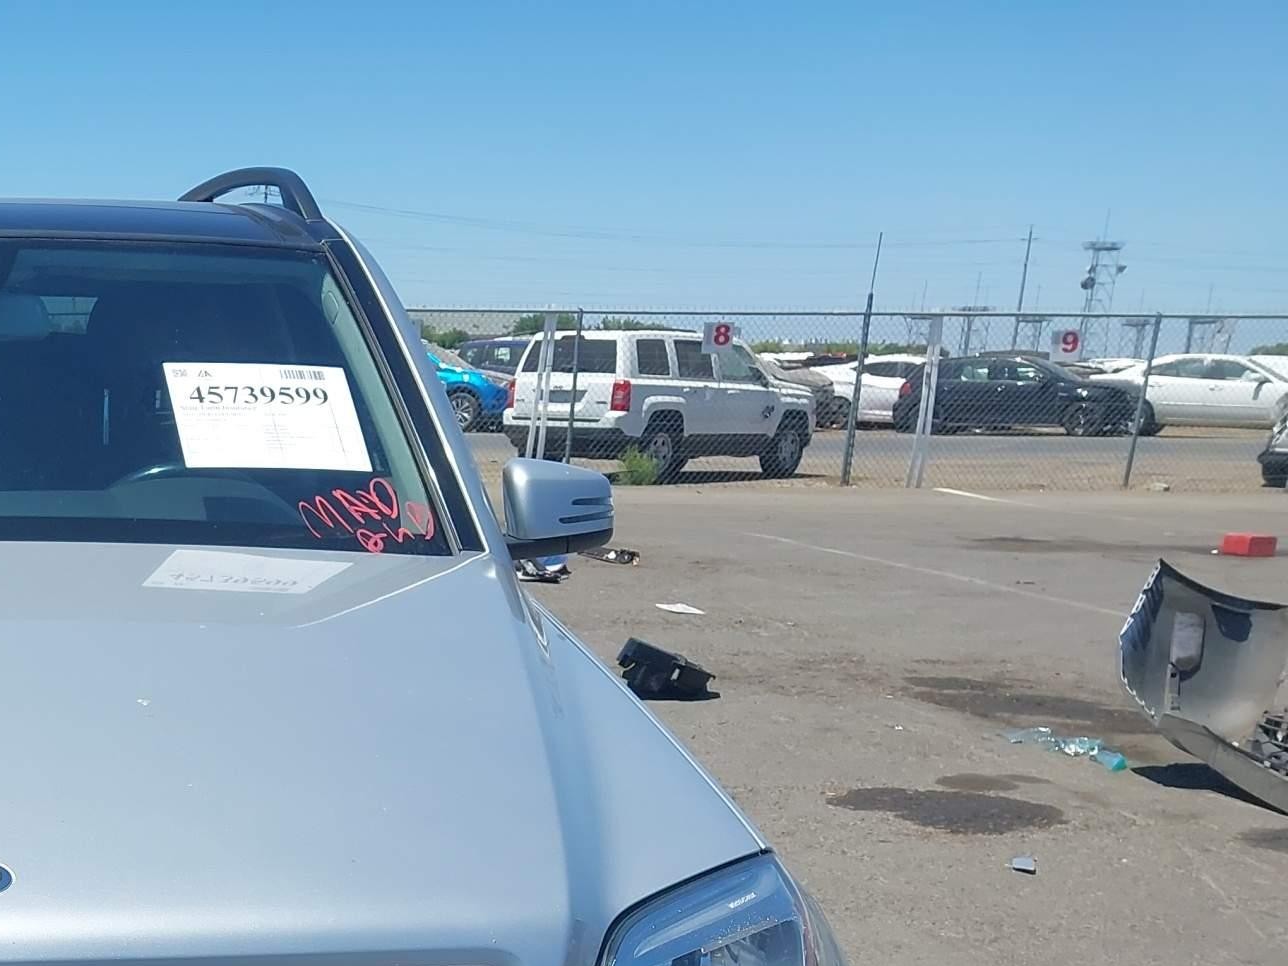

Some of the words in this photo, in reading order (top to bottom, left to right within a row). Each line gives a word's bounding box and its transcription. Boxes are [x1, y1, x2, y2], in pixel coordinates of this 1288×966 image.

[714, 324, 730, 346] 8
[1062, 331, 1079, 353] 9
[189, 385, 329, 406] 45739599
